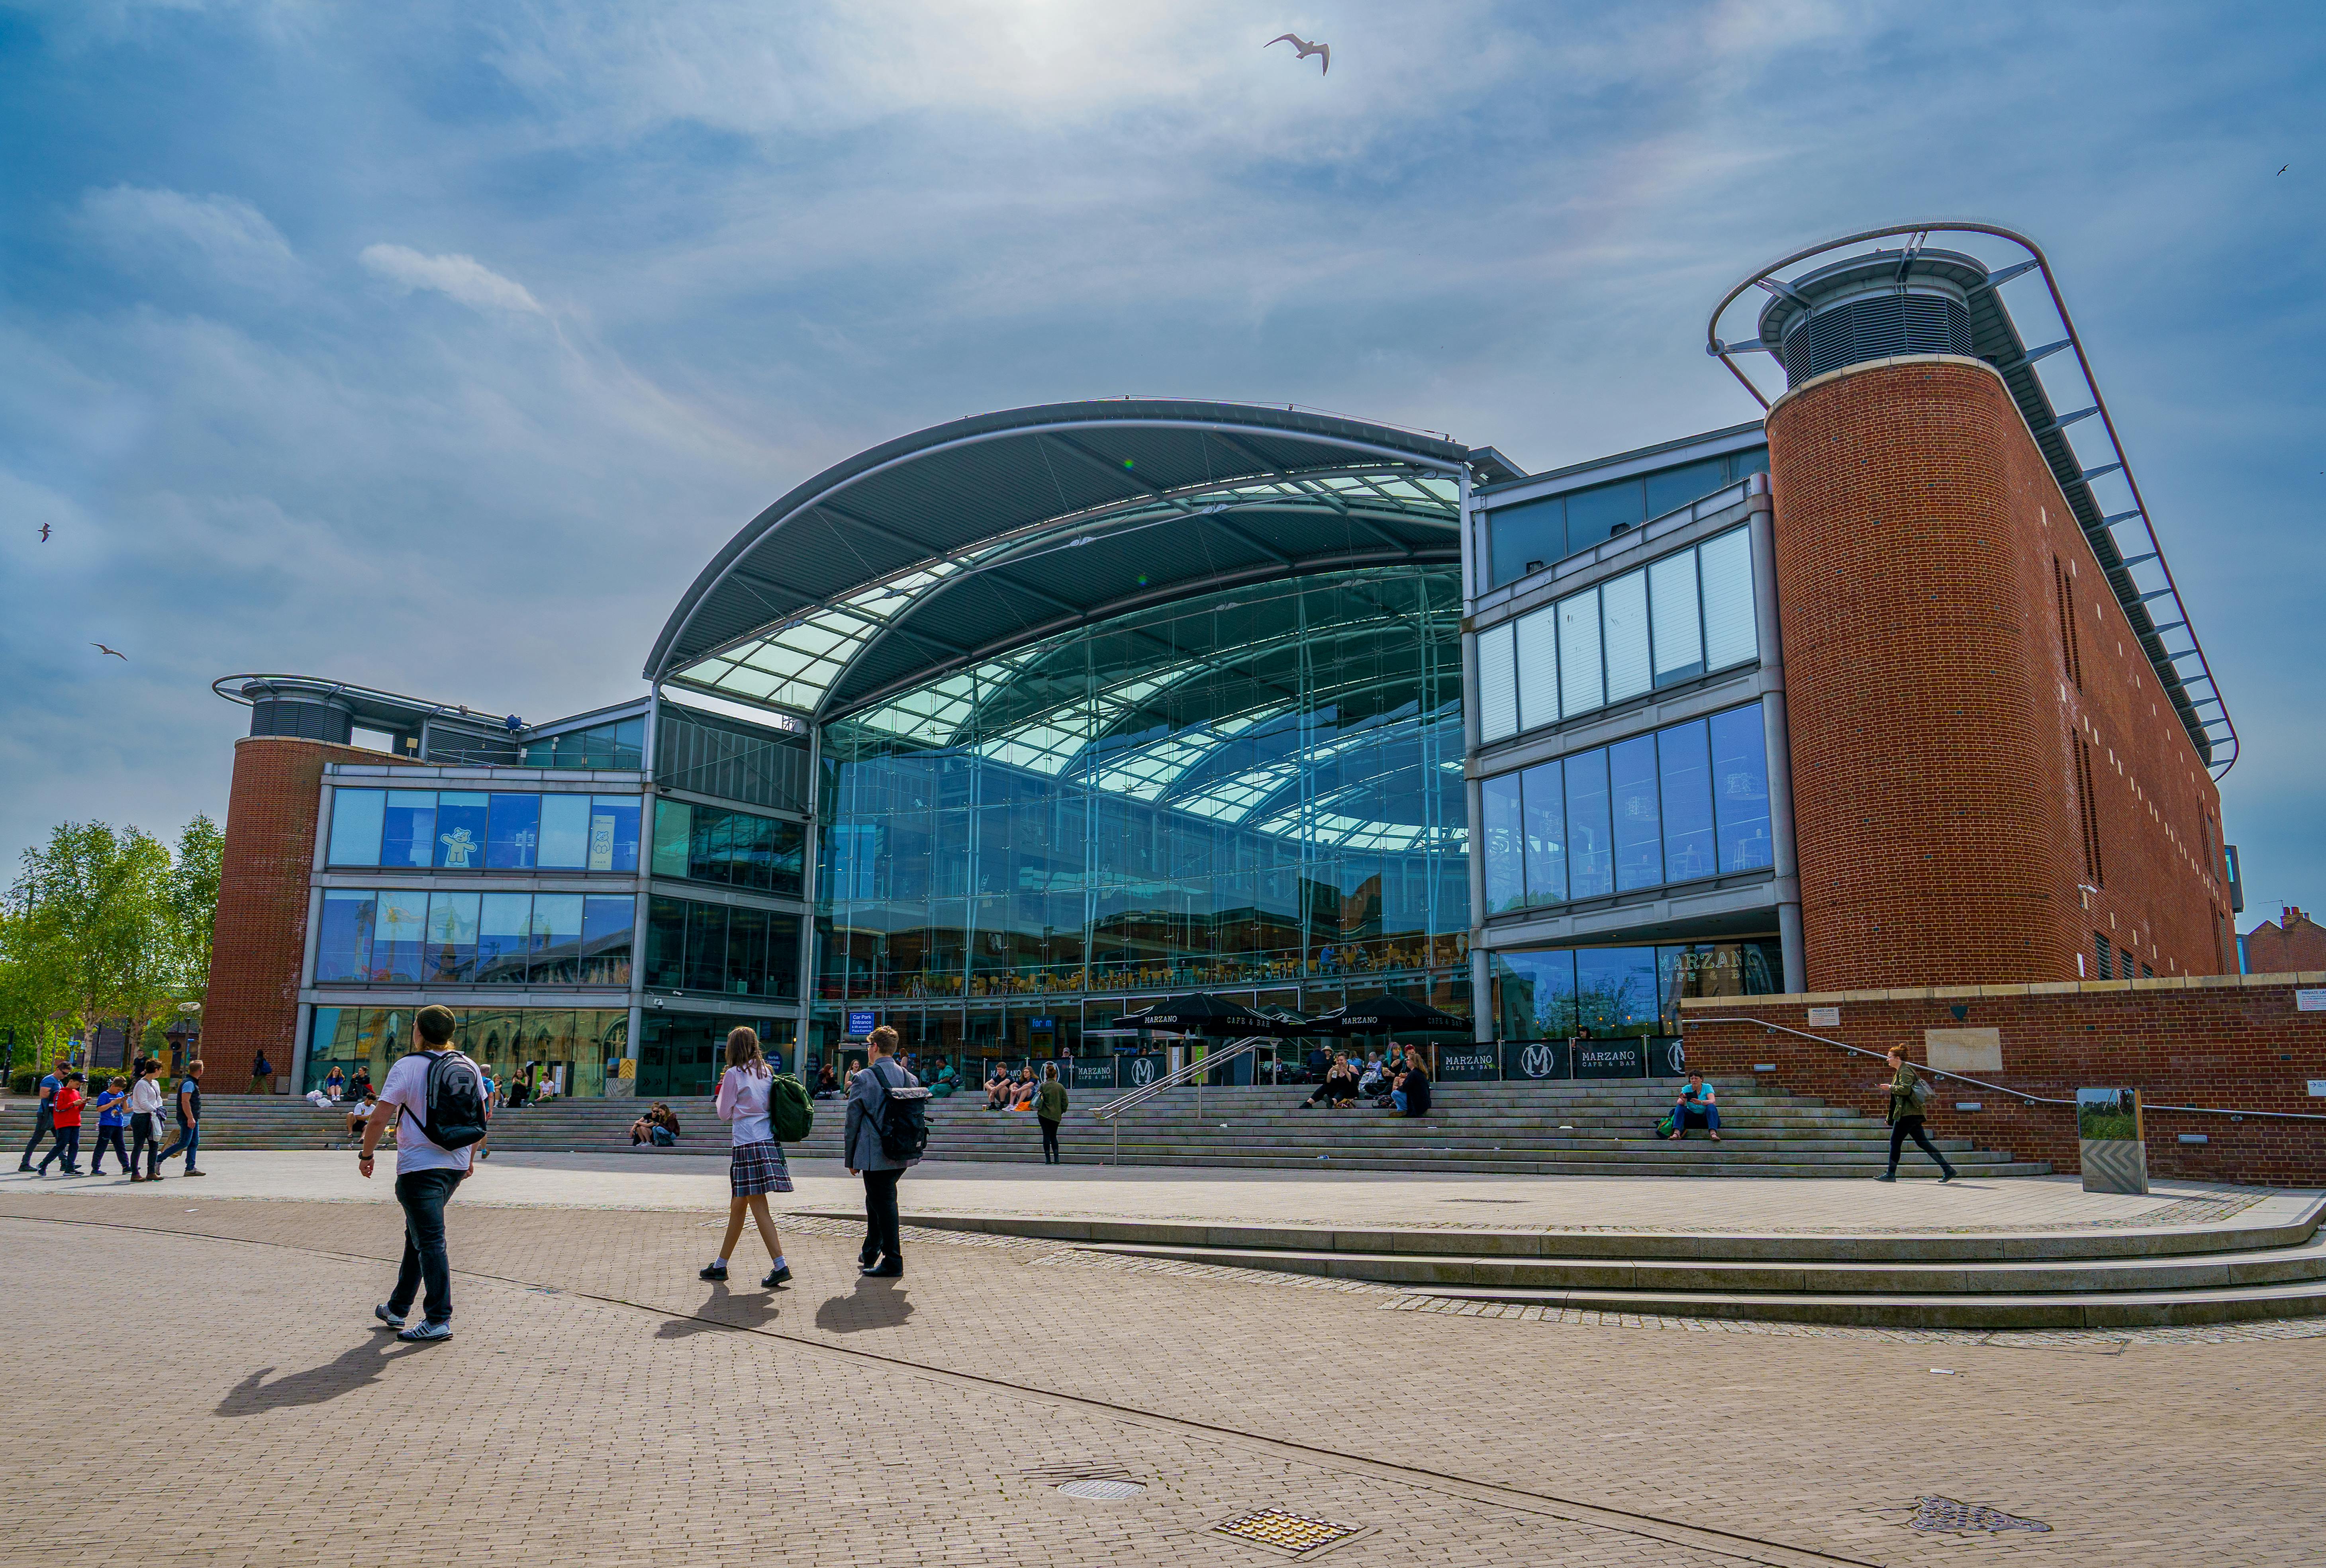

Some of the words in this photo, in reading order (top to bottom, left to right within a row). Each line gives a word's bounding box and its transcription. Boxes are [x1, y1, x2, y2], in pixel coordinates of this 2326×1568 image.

[1659, 949, 1761, 971] MARZANO
[1709, 971, 1718, 980] &
[1446, 1055, 1492, 1065] MARZANO
[1582, 1051, 1635, 1061] MARZANO
